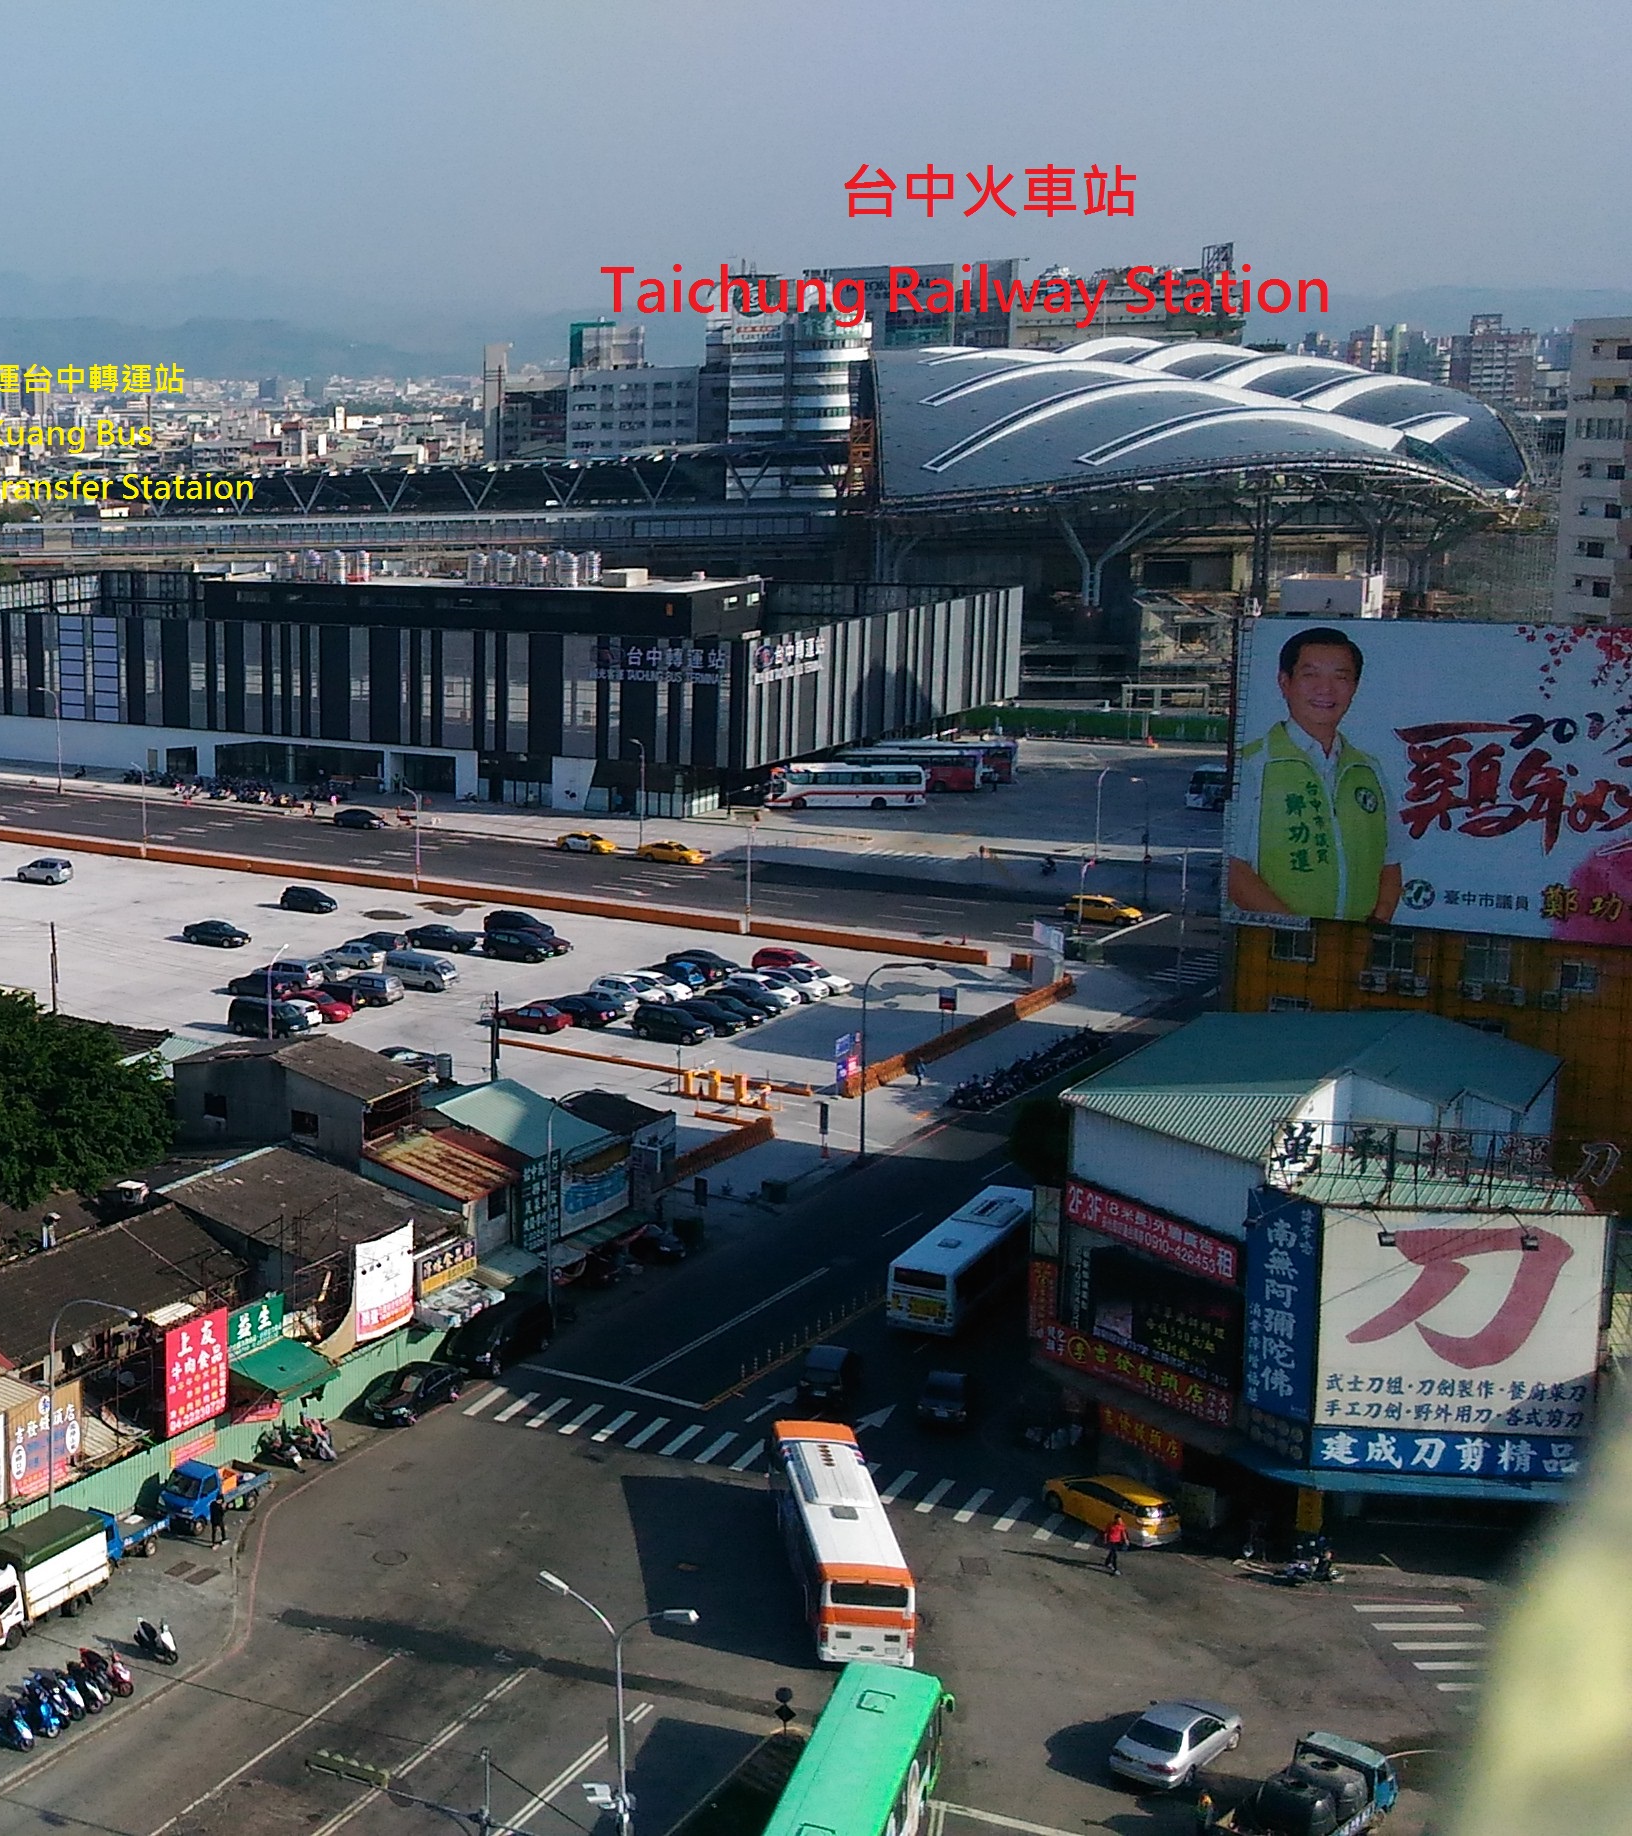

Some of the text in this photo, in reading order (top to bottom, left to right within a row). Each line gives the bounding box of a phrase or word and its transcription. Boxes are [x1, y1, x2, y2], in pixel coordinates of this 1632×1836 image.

[626, 645, 727, 670] 台中轉運站
[1443, 888, 1530, 912] 臺中市議員
[1539, 881, 1632, 923] 鄭功
[1217, 1246, 1234, 1279] 租
[1260, 1217, 1299, 1398] 南無阿彌陀佛
[1345, 1225, 1575, 1370] 刀
[170, 1342, 224, 1382] 牛肉食品
[1320, 1431, 1583, 1474] 建成刀剪精品
